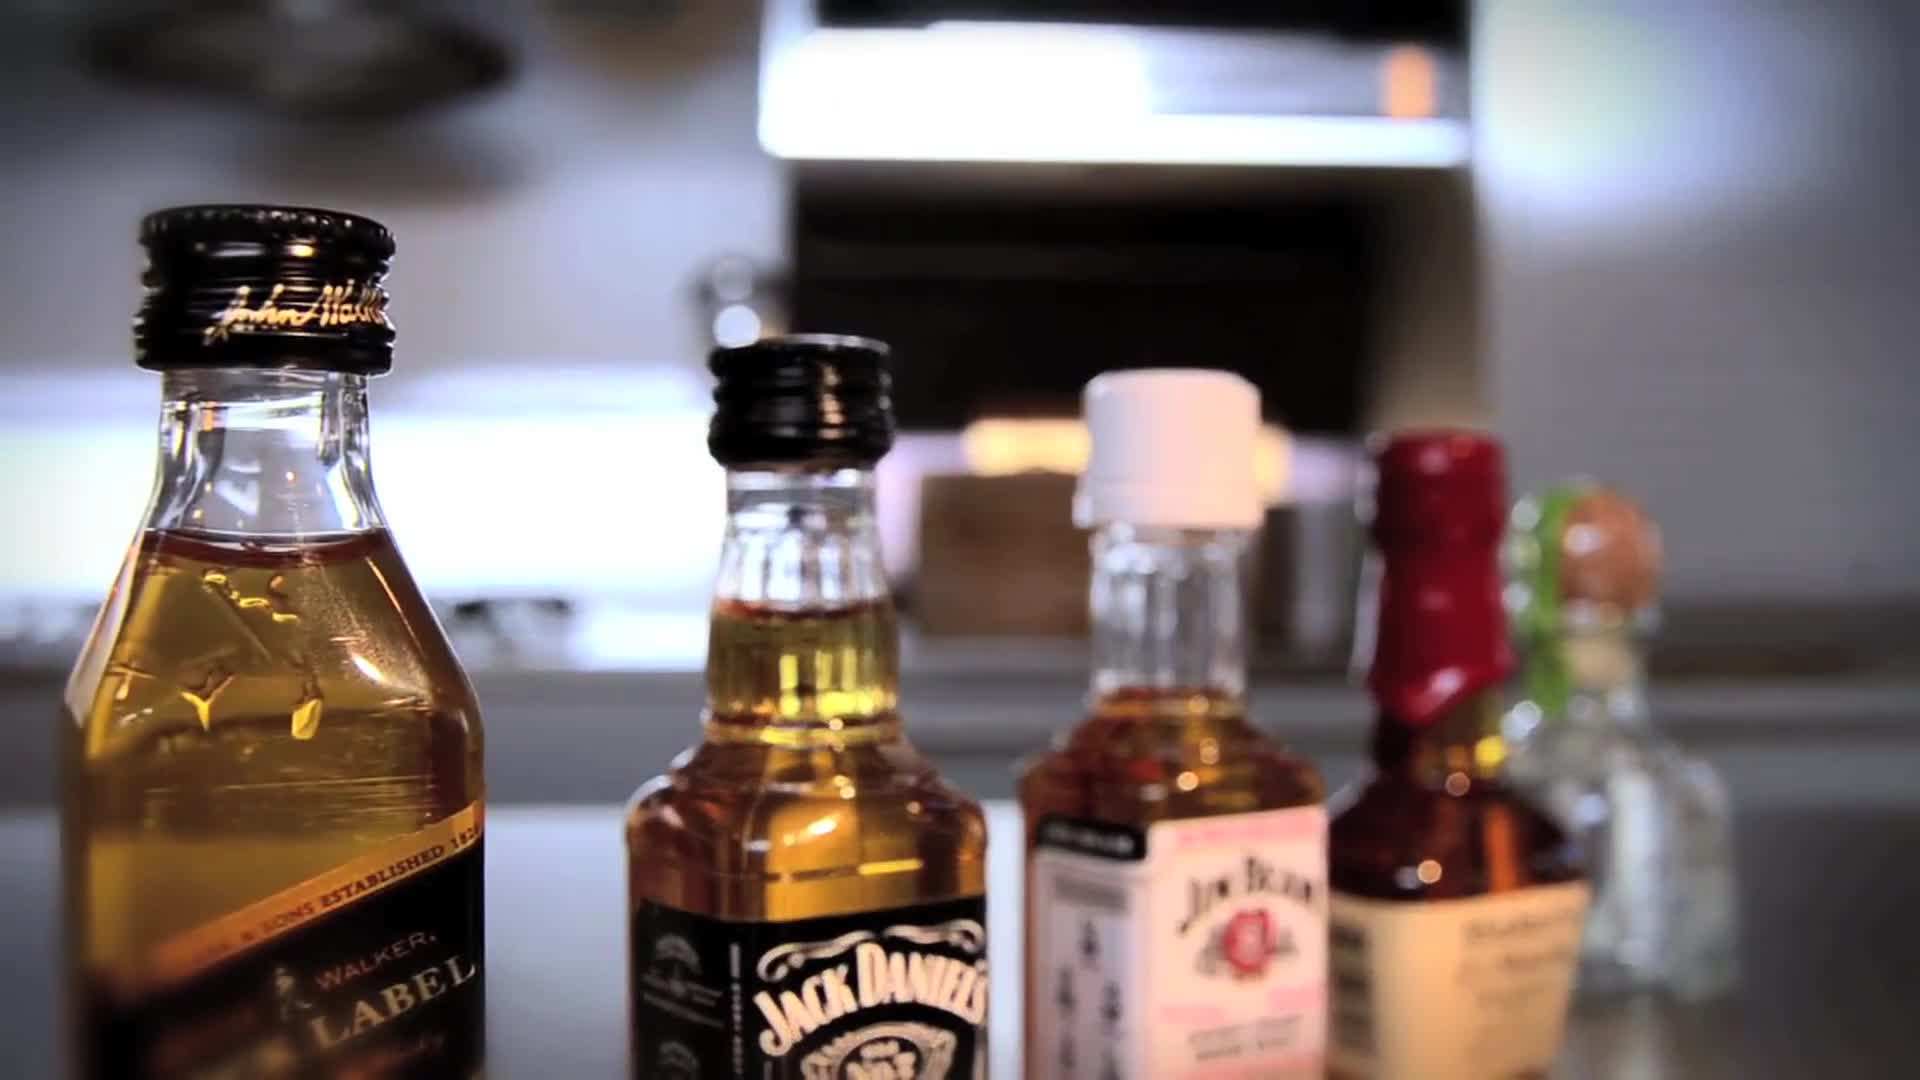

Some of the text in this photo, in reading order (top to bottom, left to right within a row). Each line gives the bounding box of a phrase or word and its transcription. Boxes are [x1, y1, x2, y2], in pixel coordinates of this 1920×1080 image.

[260, 902, 314, 933] SONS
[320, 844, 445, 906] ESTABLISHED
[310, 956, 477, 1049] LABEL
[752, 964, 858, 1056] JACK
[855, 942, 986, 1025] DANIEL'S
